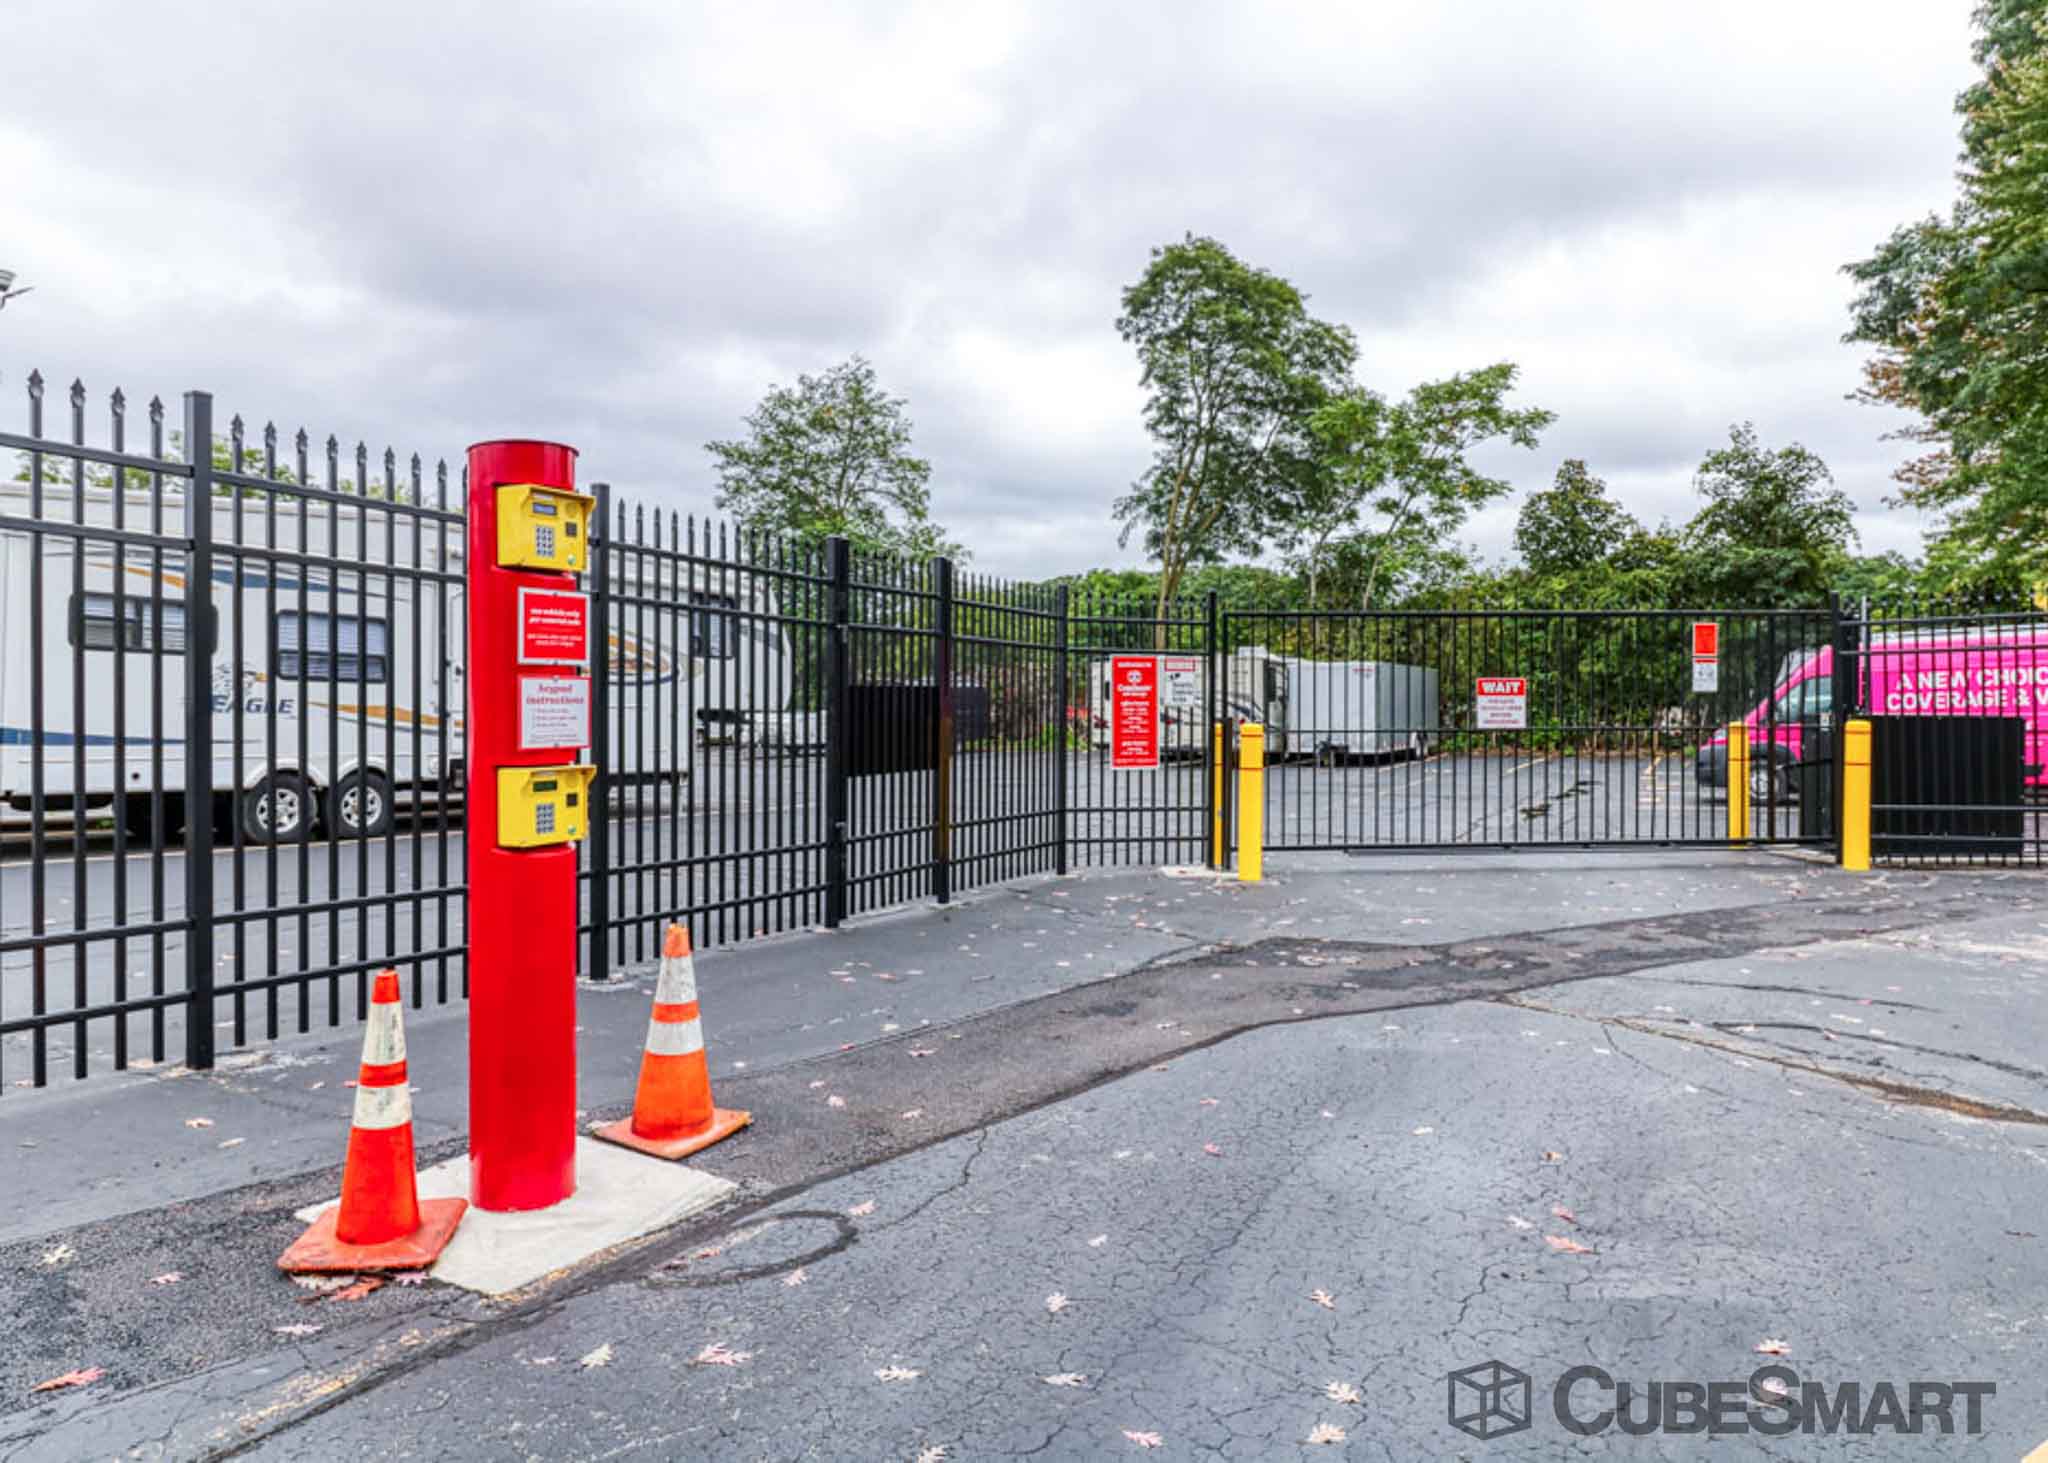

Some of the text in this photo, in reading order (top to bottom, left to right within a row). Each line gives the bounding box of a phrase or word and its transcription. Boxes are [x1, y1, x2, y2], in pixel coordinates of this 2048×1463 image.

[1481, 681, 1521, 693] WAIT
[1896, 671, 1913, 690] A
[208, 694, 295, 713] EAGE
[1887, 688, 2008, 710] COVERAGE
